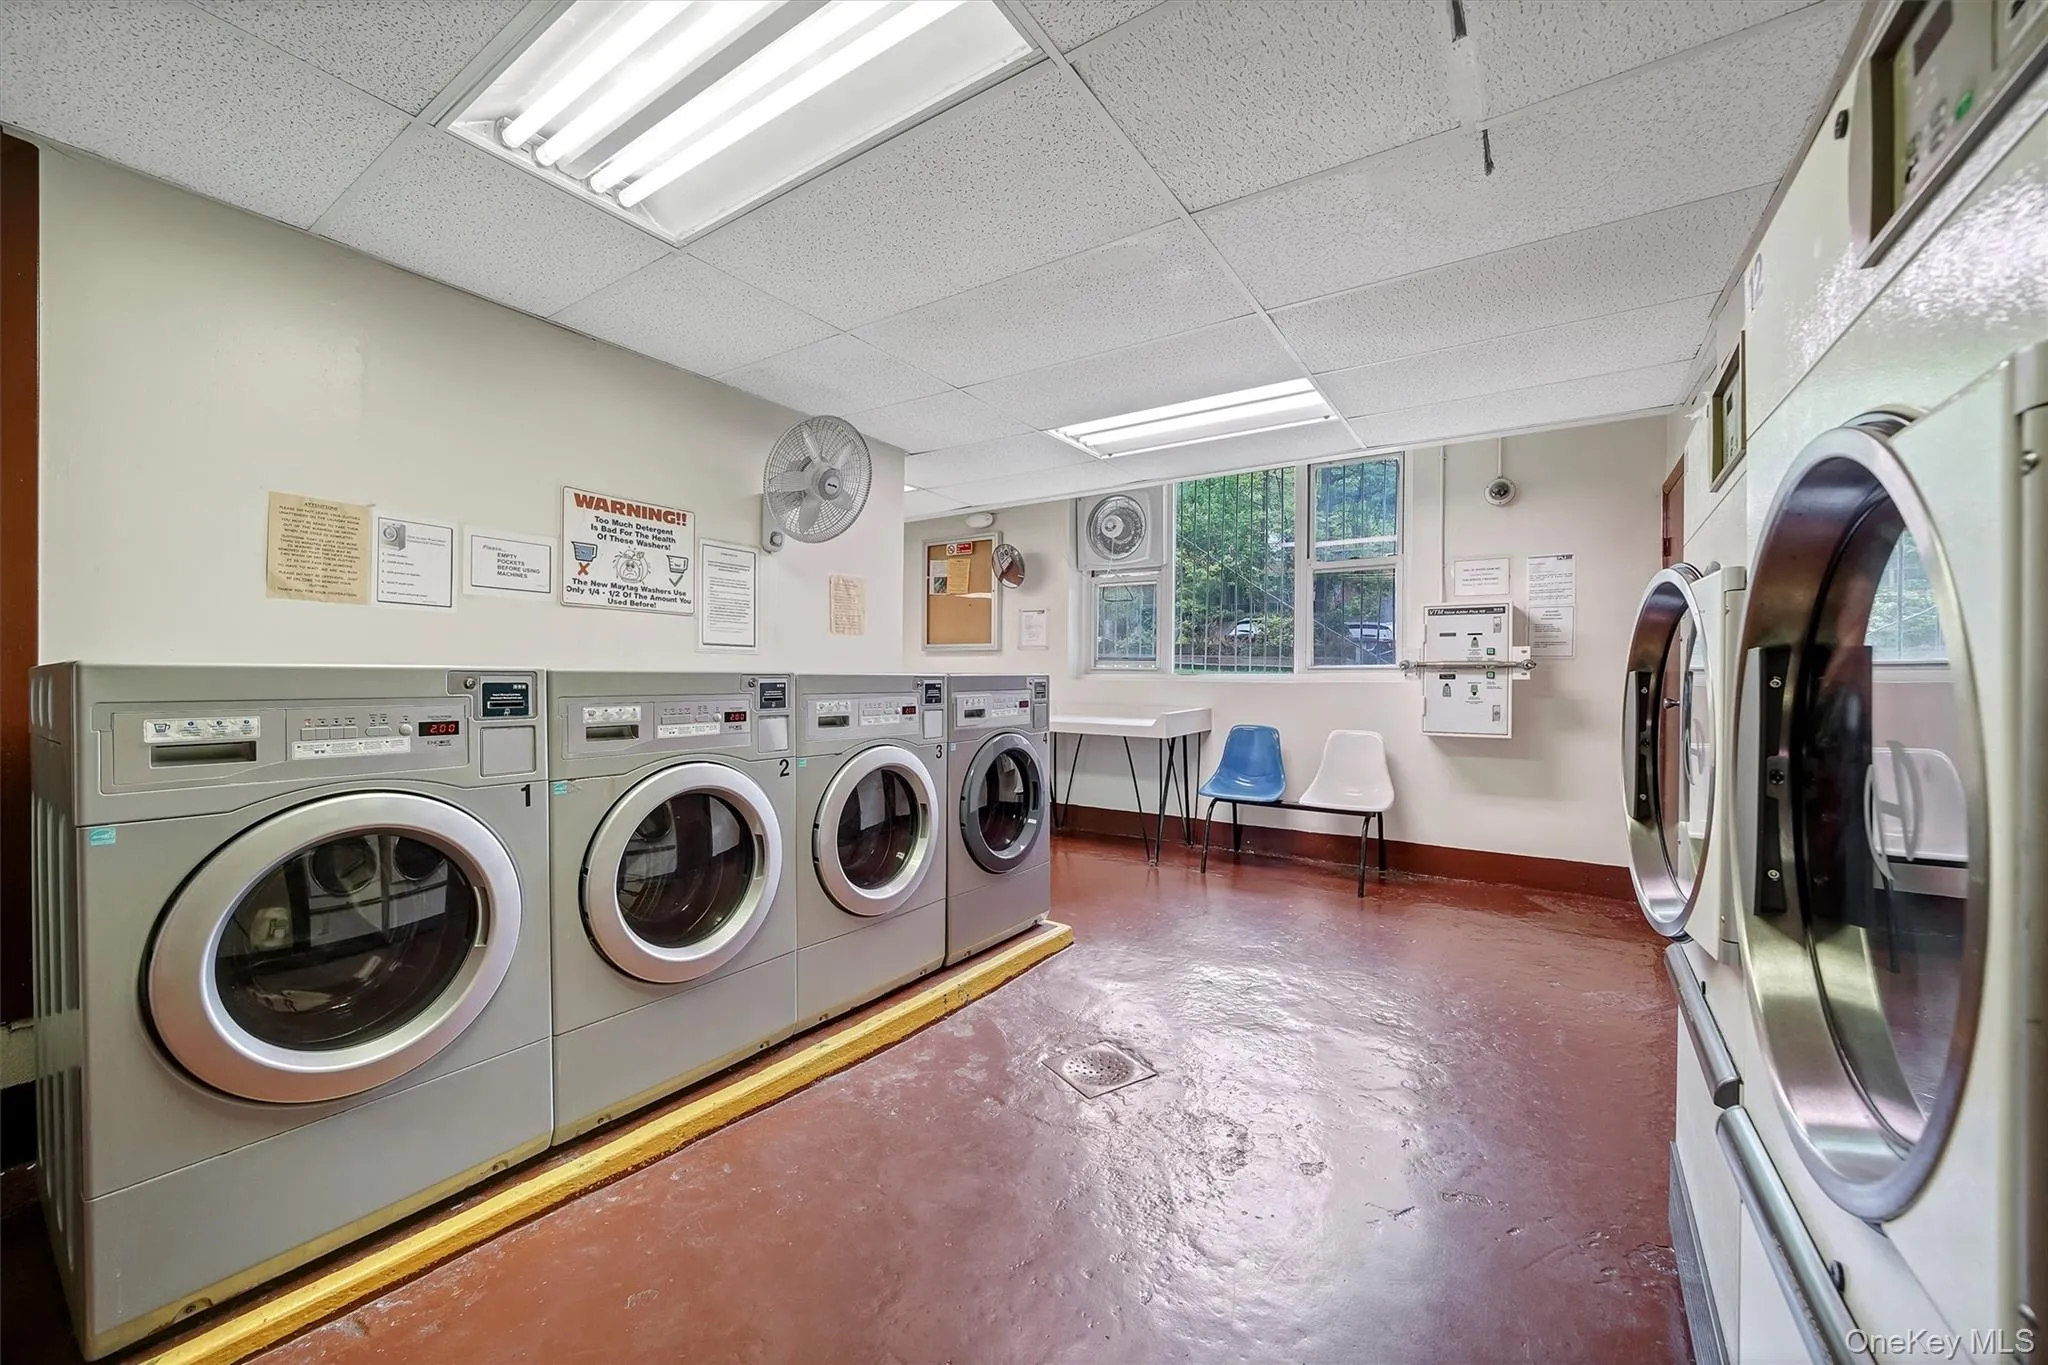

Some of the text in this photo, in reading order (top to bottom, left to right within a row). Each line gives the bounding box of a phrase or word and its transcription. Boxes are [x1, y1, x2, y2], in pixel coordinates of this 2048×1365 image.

[1748, 253, 1763, 309] 12
[574, 493, 686, 526] WARNING!!
[595, 515, 673, 536] Too Much Detergent
[601, 525, 617, 534] Bad
[620, 528, 632, 536] For
[635, 531, 649, 540] The
[652, 534, 676, 544] Health
[597, 533, 671, 551] Of These Washers!
[497, 571, 528, 579] MACHINES
[566, 585, 584, 595] Only
[588, 588, 599, 596] 1/4
[609, 590, 620, 598] 1/2
[622, 591, 631, 599] Of
[635, 592, 648, 600] The
[650, 594, 677, 603] Amount
[679, 597, 691, 605] You
[572, 578, 686, 597] The New Maytag Washers Use
[607, 598, 656, 609] Used Before!
[1042, 732, 1048, 744] 4
[936, 744, 942, 759] 3
[779, 759, 789, 778] 2
[521, 784, 531, 807] 1
